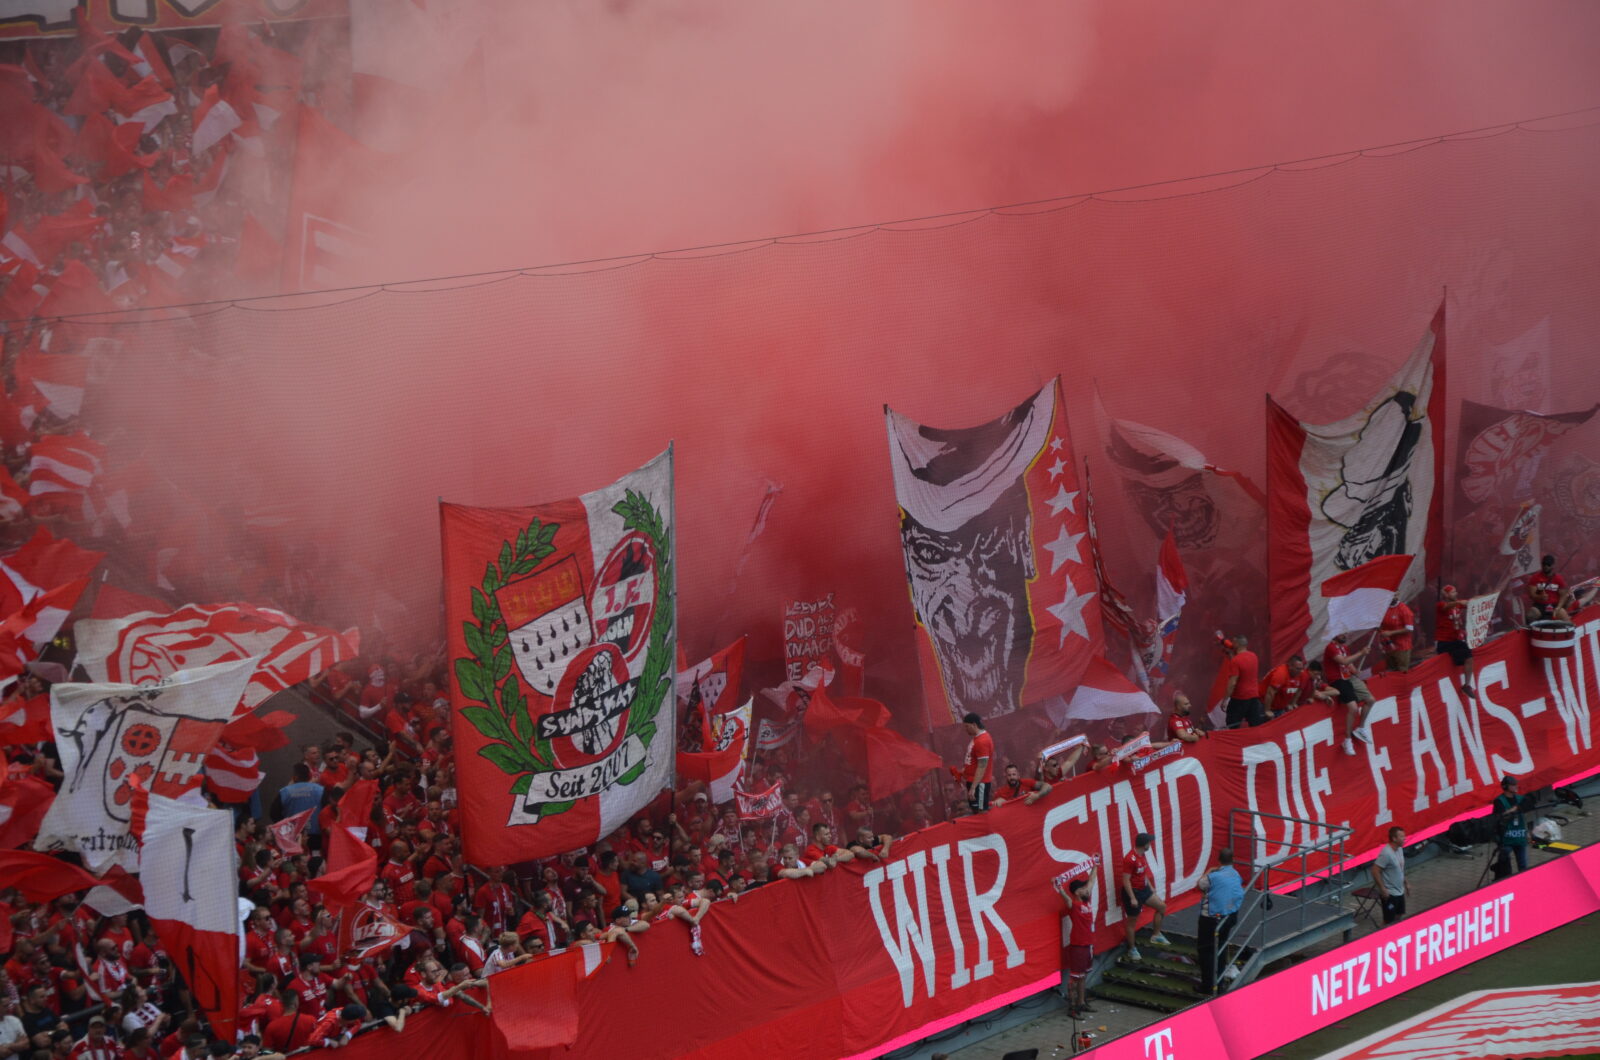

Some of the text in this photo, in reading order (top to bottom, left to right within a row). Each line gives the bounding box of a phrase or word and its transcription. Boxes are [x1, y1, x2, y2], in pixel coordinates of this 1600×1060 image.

[545, 771, 585, 798] Seit
[863, 833, 1025, 1008] WIR
[1043, 757, 1213, 948] SIND
[1242, 717, 1350, 873] DIE
[1311, 892, 1515, 1016] NETZ IST FREIHEIT
